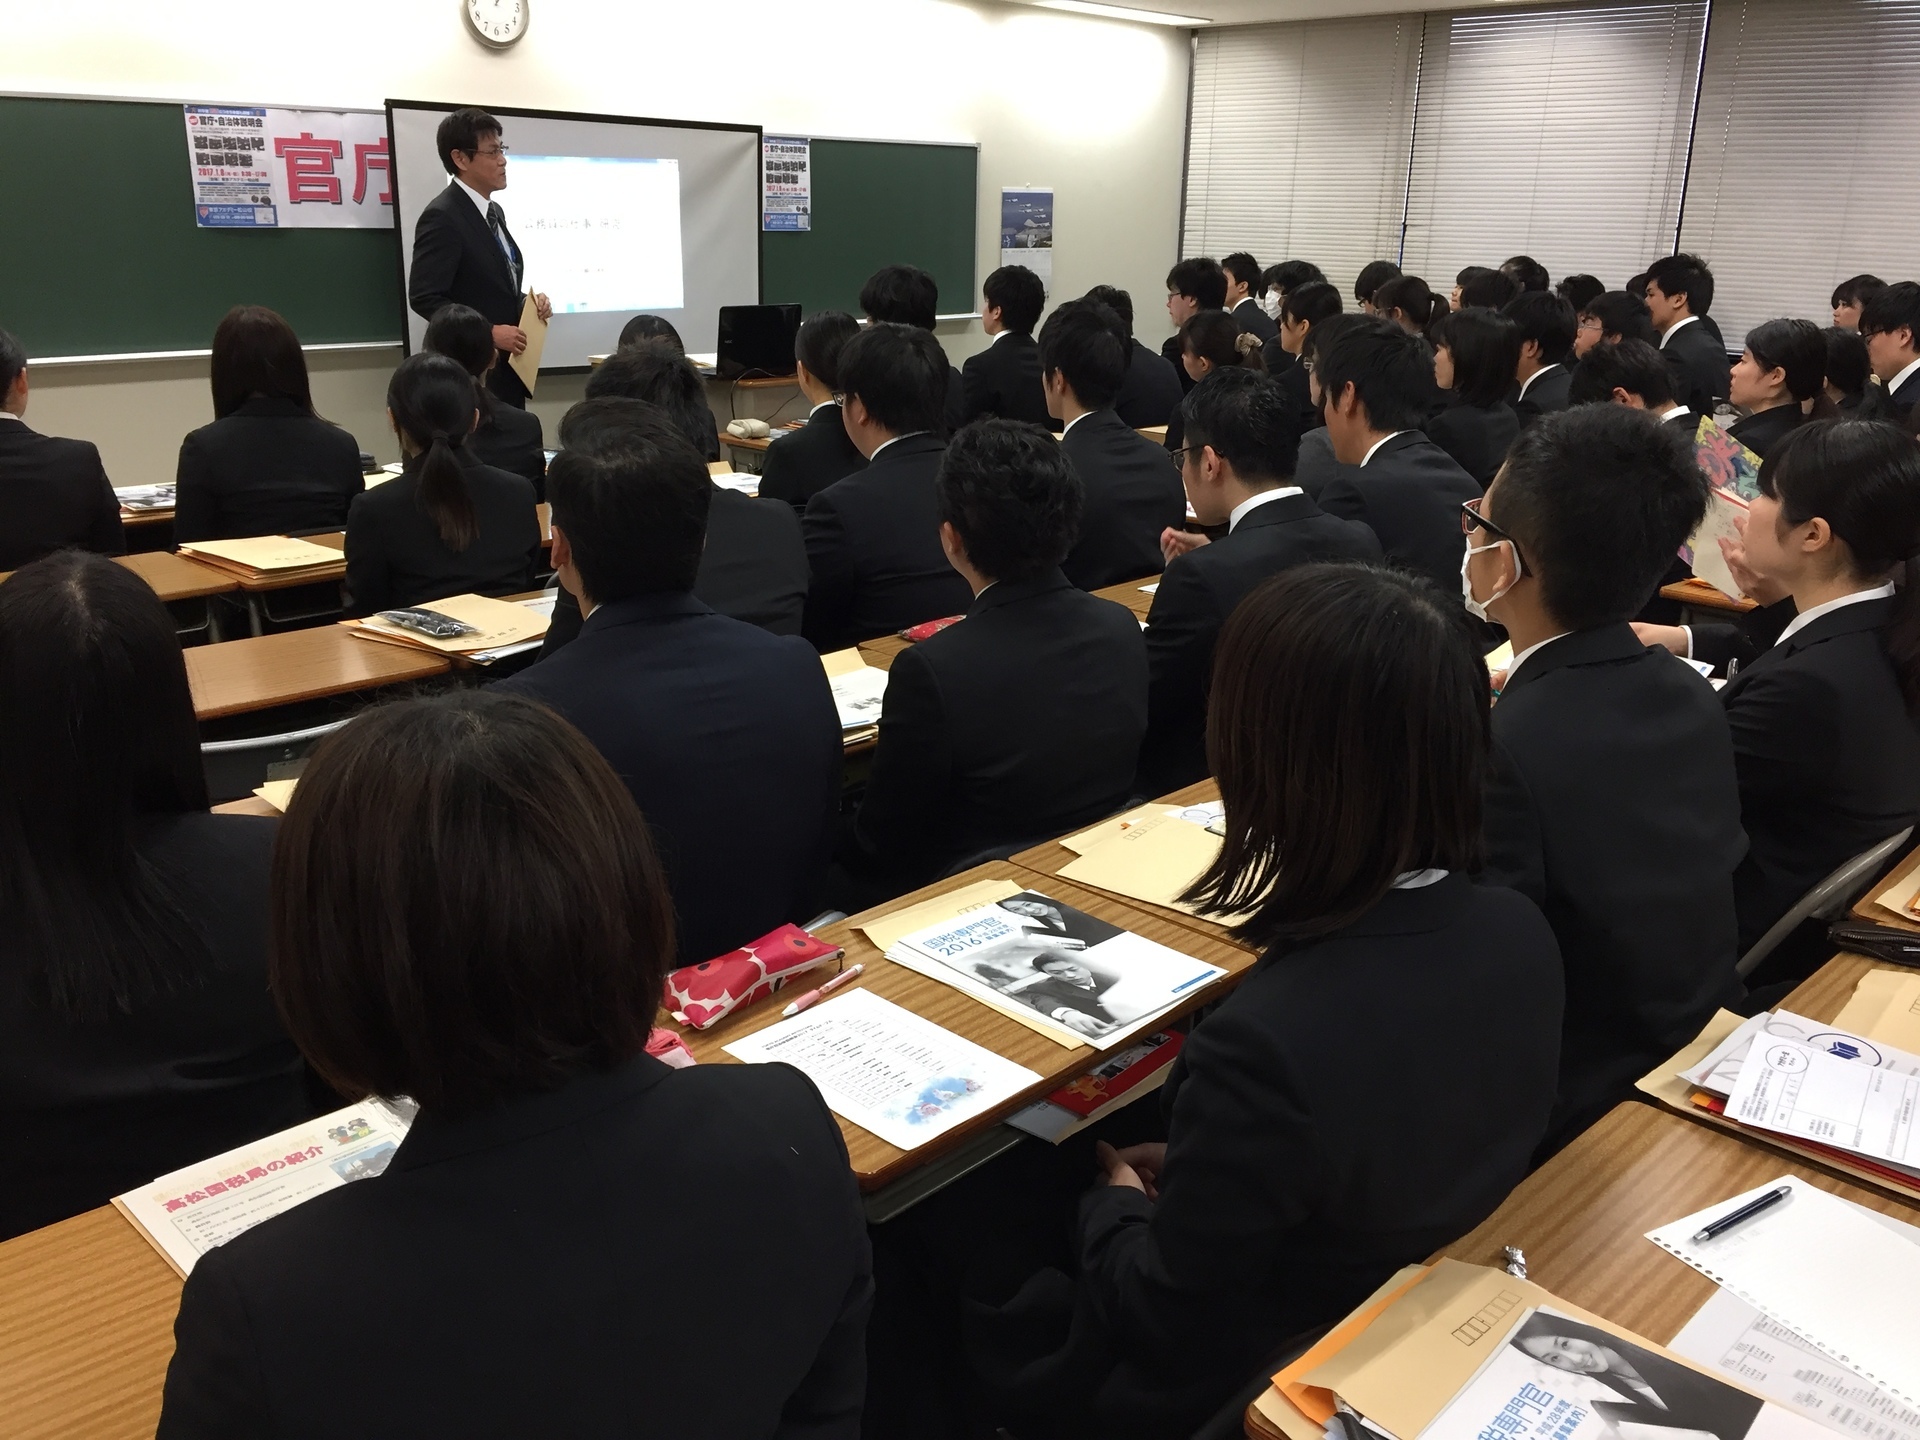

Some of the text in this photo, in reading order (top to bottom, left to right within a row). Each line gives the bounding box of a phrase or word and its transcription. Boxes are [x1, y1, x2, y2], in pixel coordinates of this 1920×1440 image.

[515, 2, 520, 13] 3
[475, 10, 480, 21] 8
[512, 16, 516, 26] 4
[484, 21, 488, 31] 7
[494, 26, 499, 36] 6
[505, 23, 510, 34] 5
[922, 916, 1003, 950] 国税専門官
[938, 937, 983, 957] 2016
[161, 1146, 324, 1213] 高松国税局の紹介
[1535, 1399, 1573, 1436] 平成28年度
